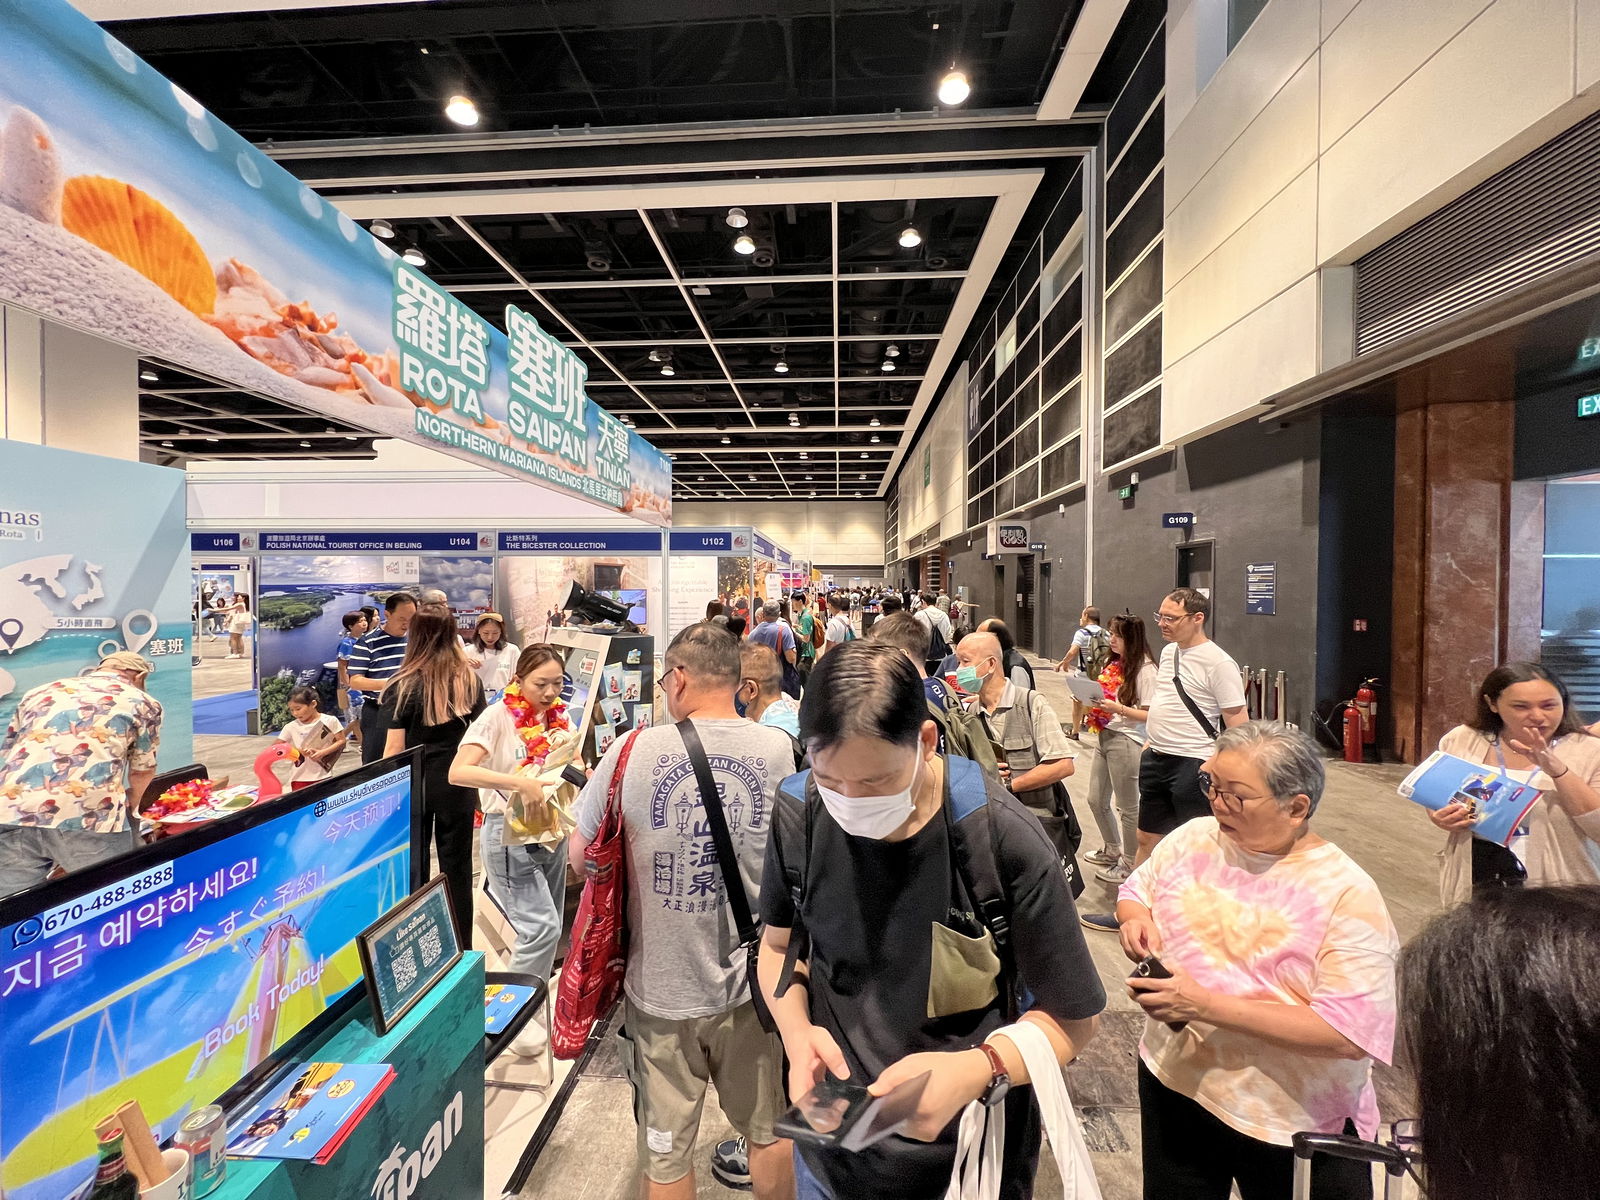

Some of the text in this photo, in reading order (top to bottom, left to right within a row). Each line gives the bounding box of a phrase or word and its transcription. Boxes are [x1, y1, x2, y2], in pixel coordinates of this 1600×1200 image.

[397, 267, 487, 385] 羅塔
[403, 353, 482, 420] ROTA
[511, 312, 587, 432] 塞班
[416, 412, 582, 489] NORTHERN MARIANA ISLANDS
[509, 401, 586, 464] SAIPAN
[598, 412, 629, 462] 天寧
[595, 457, 630, 488] TINIAN
[213, 538, 233, 546] U106
[449, 537, 471, 546] U104
[702, 537, 724, 546] U102
[1003, 536, 1027, 545] KIOSK
[1168, 516, 1188, 524] G109
[57, 618, 103, 628] 5小時直飛
[150, 638, 184, 656] 塞班
[654, 758, 761, 823] YAMAGATA GZAN ONSEN JAPAN
[44, 866, 173, 931] 670-488-8888
[2, 857, 257, 997] 지금 예약하세요!
[204, 953, 325, 1058] Book Today!
